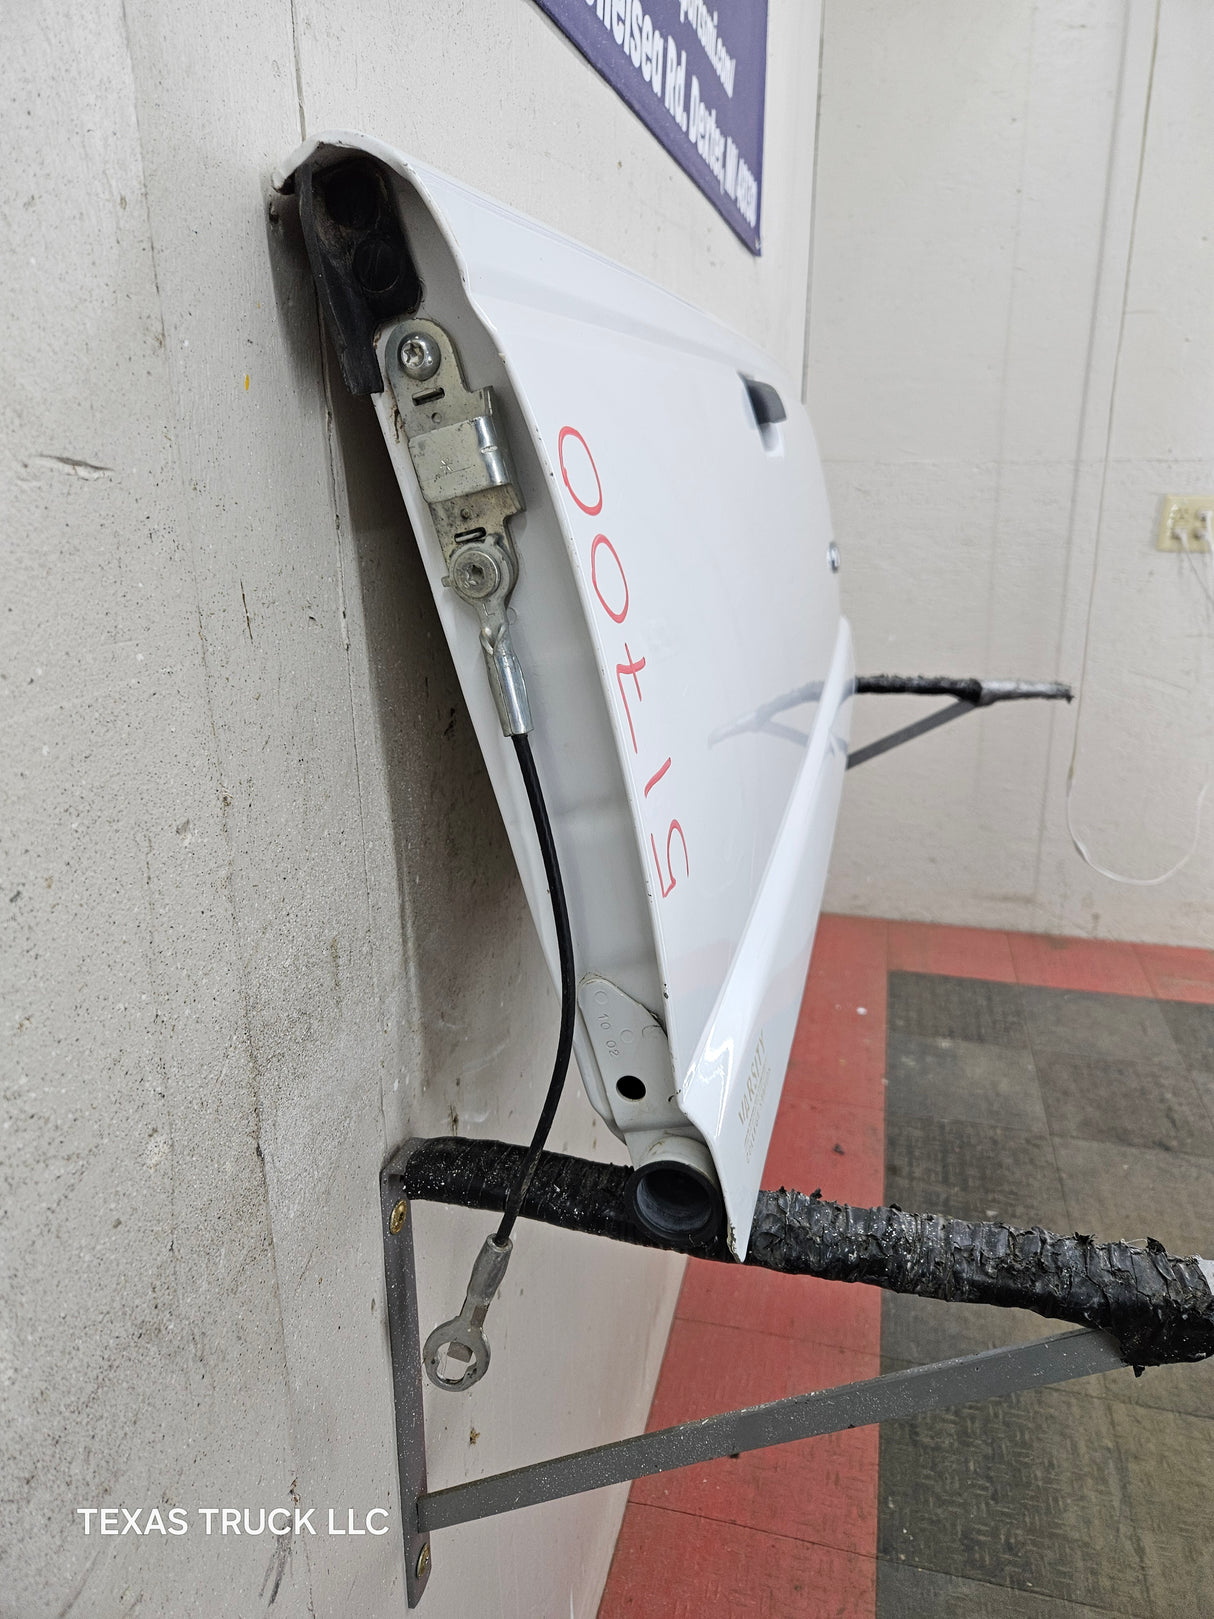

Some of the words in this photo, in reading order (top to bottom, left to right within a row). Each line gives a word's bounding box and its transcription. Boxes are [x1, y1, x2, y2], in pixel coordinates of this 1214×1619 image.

[585, 0, 664, 98] elsea
[664, 35, 687, 132] Rd.
[738, 1027, 765, 1126] VARSITY
